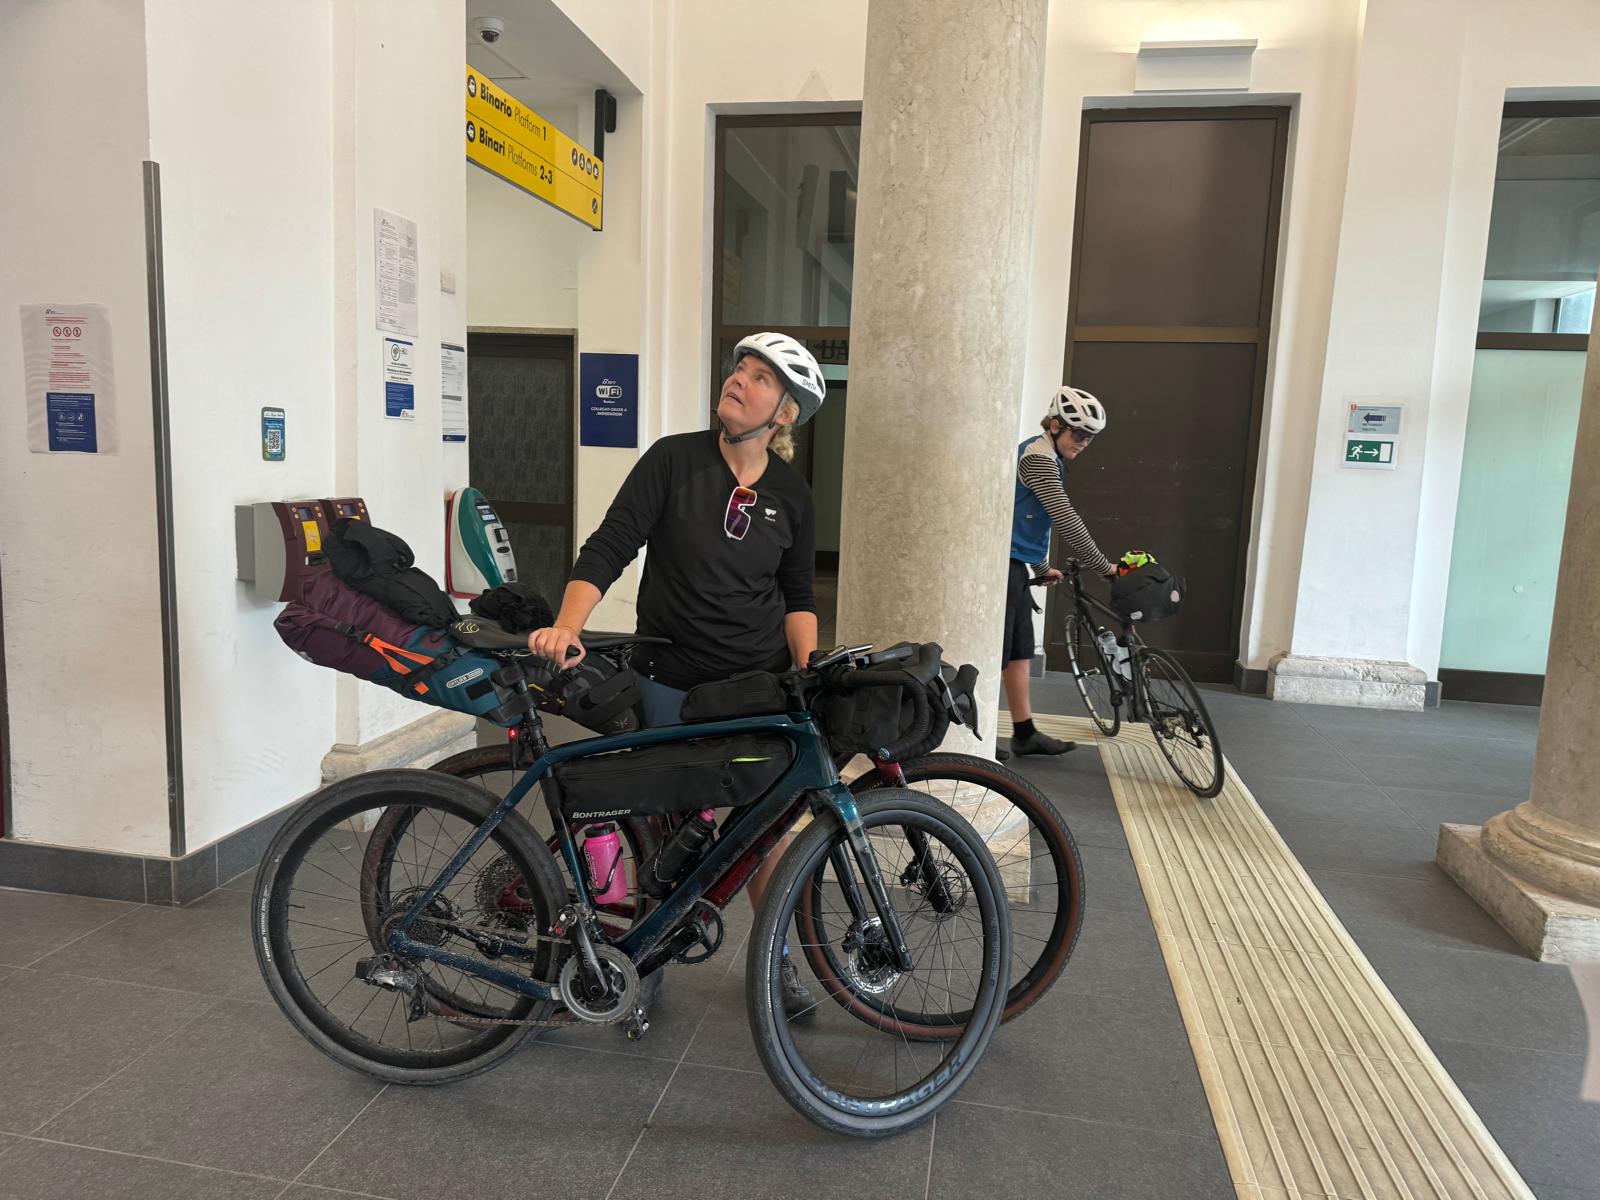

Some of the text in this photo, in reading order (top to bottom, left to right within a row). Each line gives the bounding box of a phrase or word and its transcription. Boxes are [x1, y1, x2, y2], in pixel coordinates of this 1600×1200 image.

[480, 82, 546, 141] Binario Platform 1
[479, 126, 553, 185] Binari Platforms 2-3
[572, 808, 631, 819] BONTRAGER
